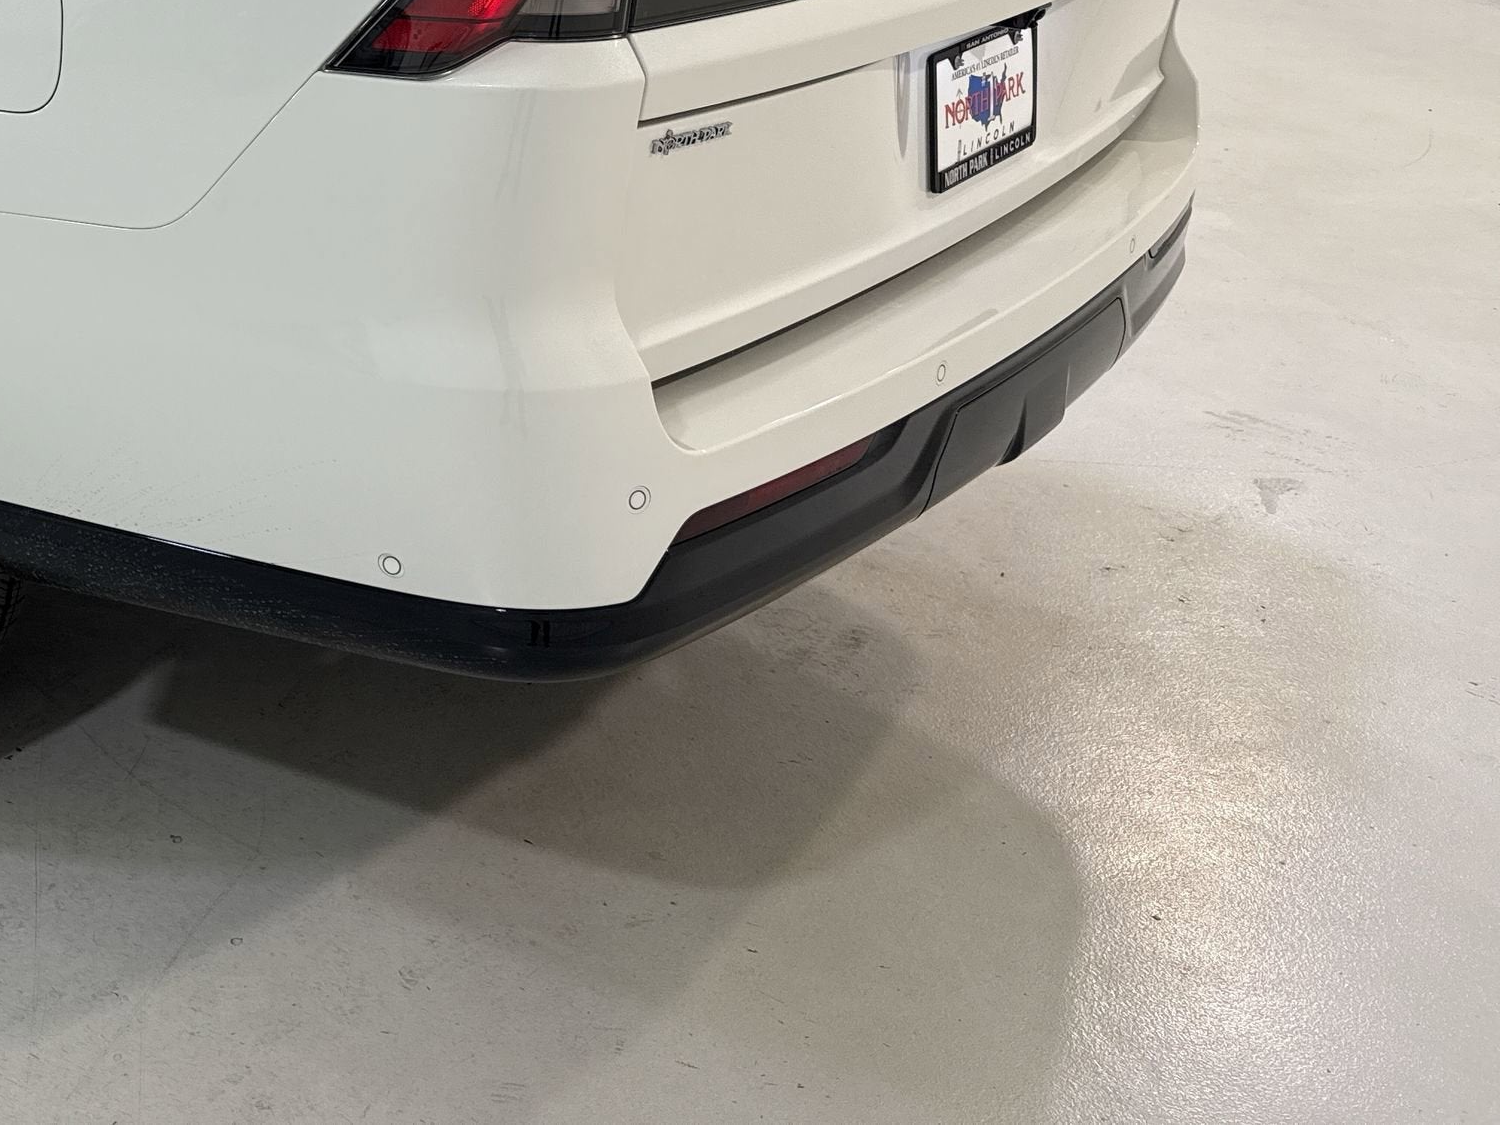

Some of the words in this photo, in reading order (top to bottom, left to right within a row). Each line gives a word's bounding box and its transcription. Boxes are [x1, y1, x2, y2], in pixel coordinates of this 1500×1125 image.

[966, 39, 980, 49] SAN
[981, 27, 1009, 43] ANTONIO
[944, 88, 988, 129] NORTH
[994, 71, 1026, 108] PARK
[944, 163, 969, 188] NORTH
[969, 152, 988, 178] PARK
[994, 132, 1032, 160] LINCOLN
[963, 121, 1016, 156] LINCOLN
